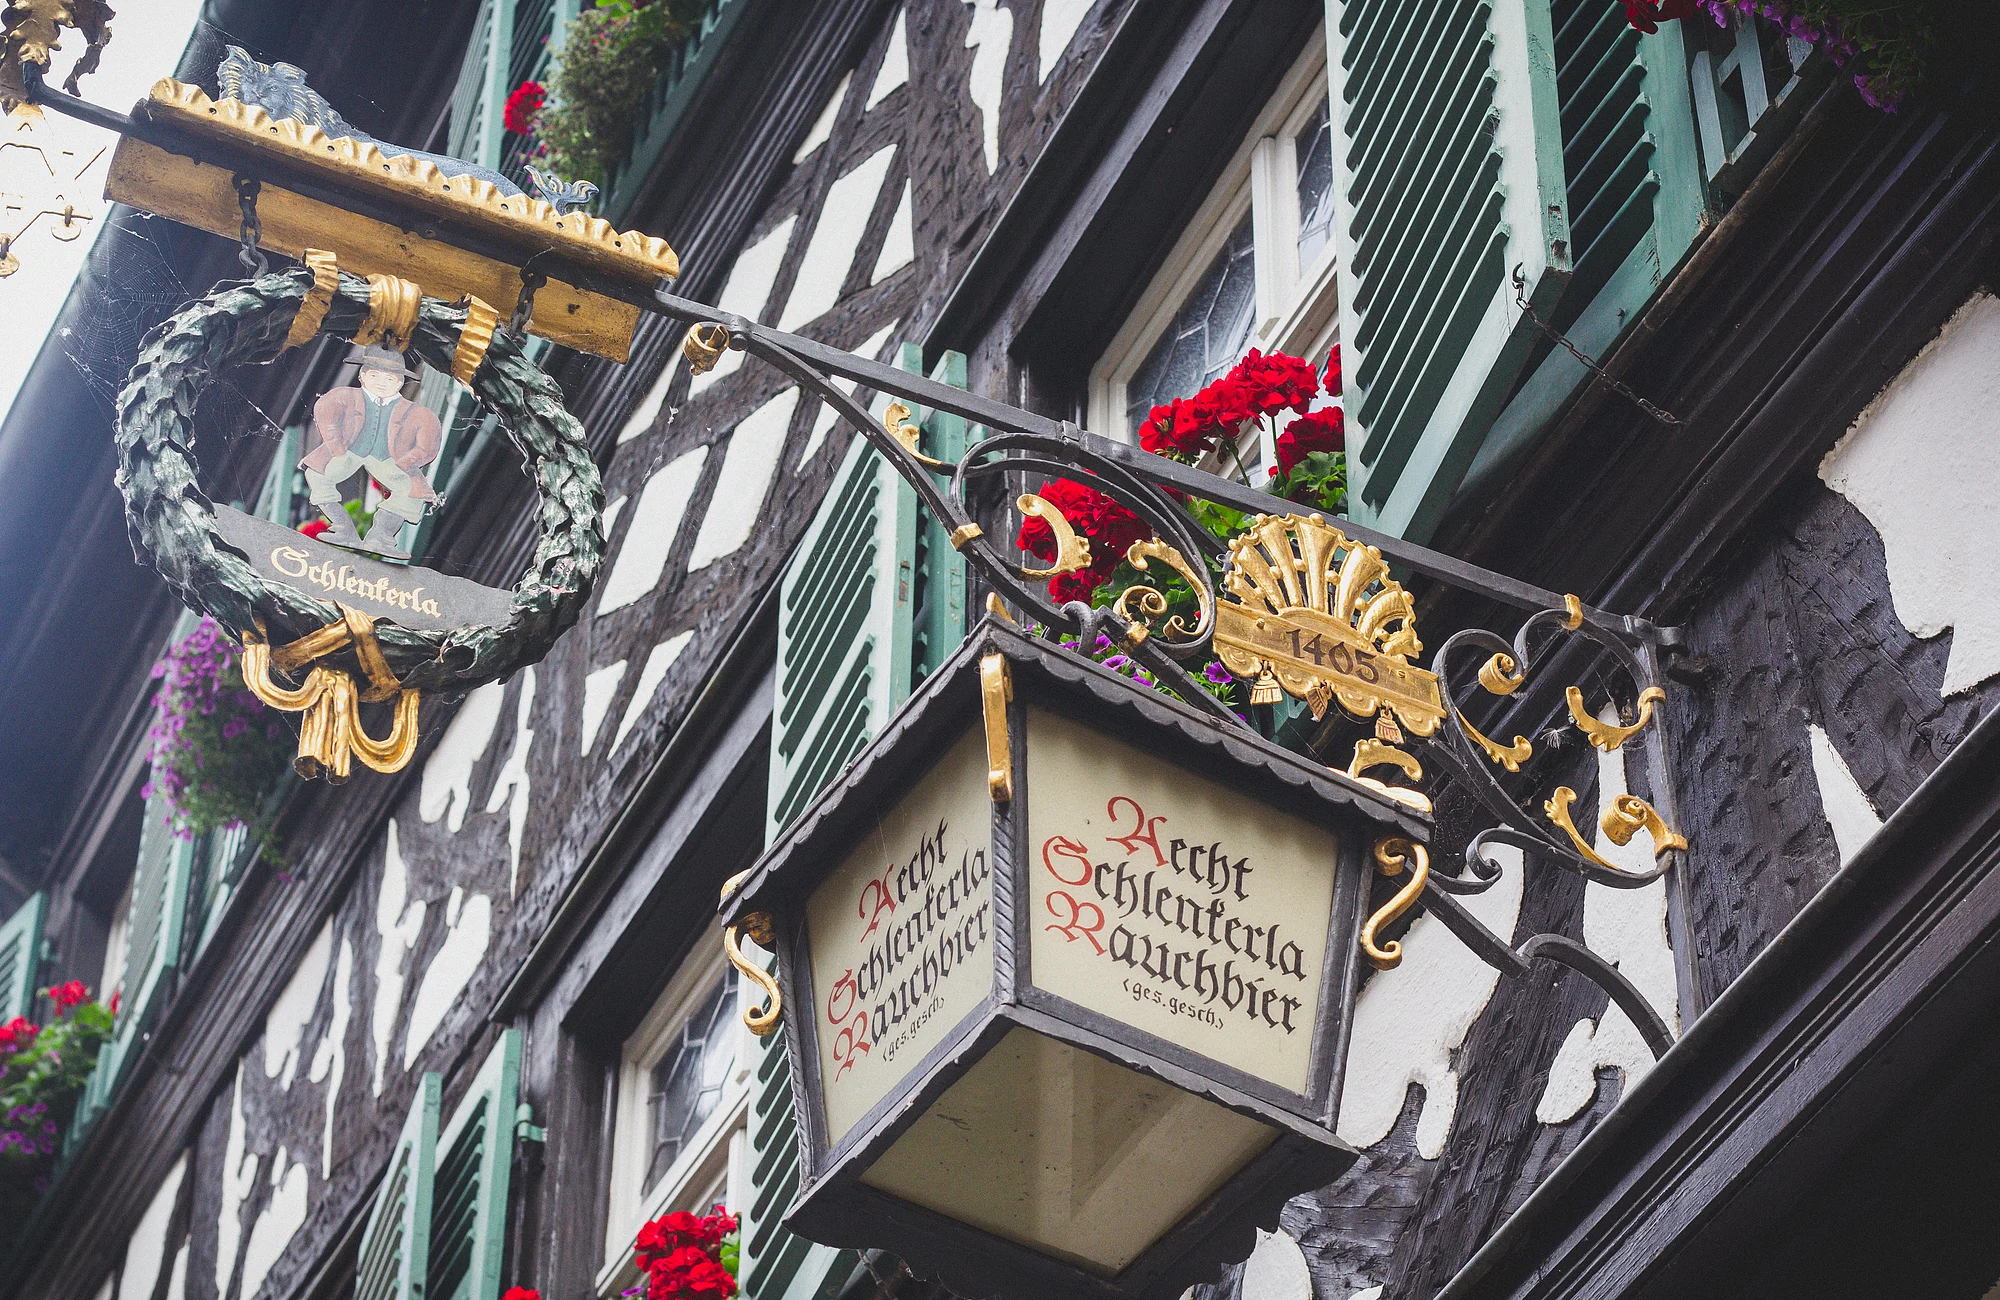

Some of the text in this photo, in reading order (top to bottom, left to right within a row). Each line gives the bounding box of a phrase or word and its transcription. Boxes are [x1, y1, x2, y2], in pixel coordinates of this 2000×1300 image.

[270, 546, 442, 618] Schlenkerla
[1286, 628, 1380, 685] 1405
[859, 817, 948, 943] Aecht
[1042, 836, 1307, 982] Schlenkerla
[1106, 796, 1253, 901] Aecht
[827, 847, 990, 1025] Schlenkerla
[833, 900, 990, 1083] Rauchbier
[1044, 891, 1302, 1035] Rauchbier
